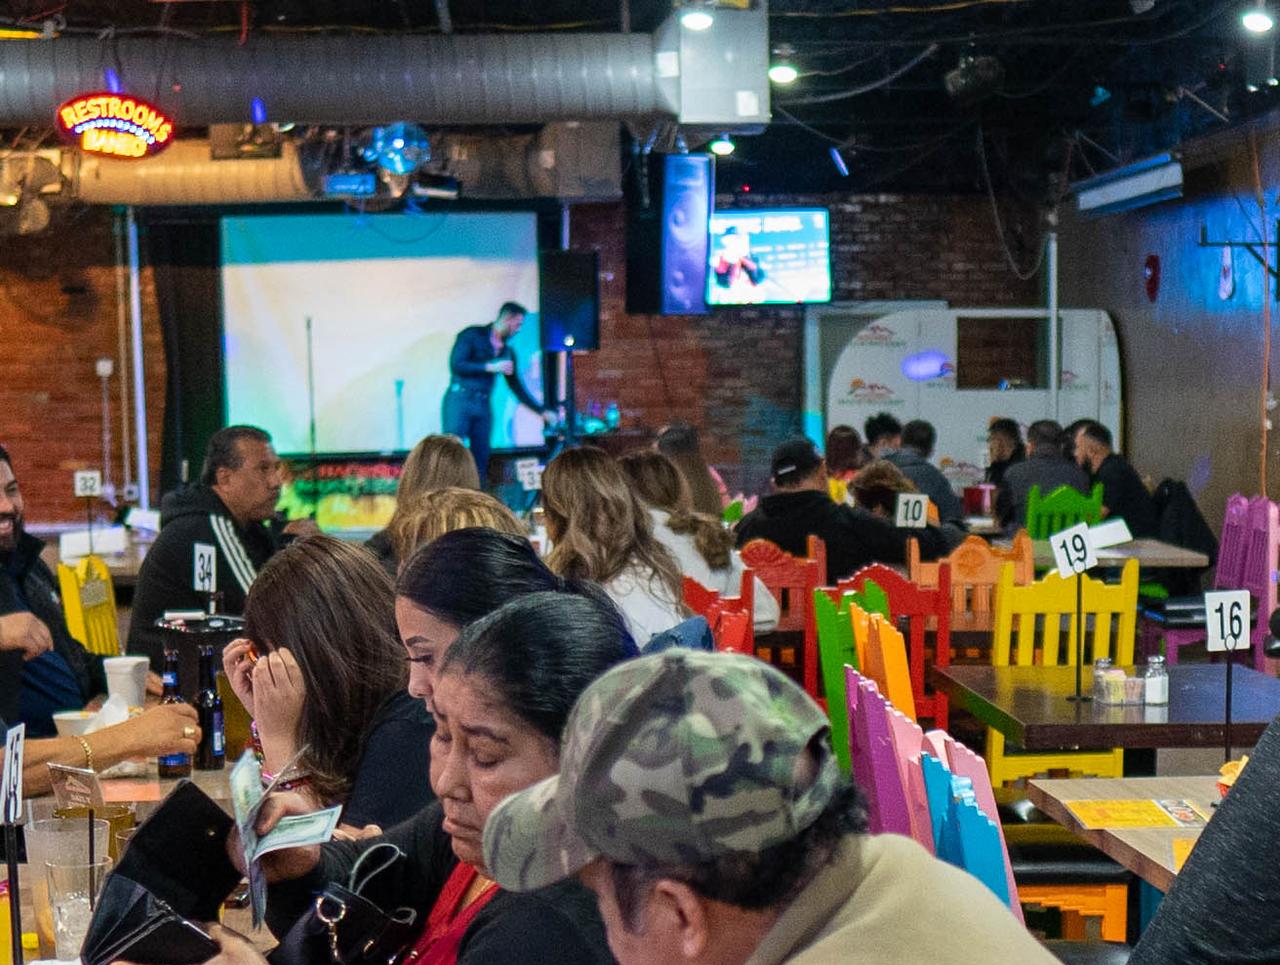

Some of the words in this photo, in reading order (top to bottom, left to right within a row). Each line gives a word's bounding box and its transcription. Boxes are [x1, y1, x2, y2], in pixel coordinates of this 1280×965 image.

[60, 97, 172, 143] RESTROOMS
[80, 476, 97, 492] 32
[903, 499, 923, 521] 10
[1059, 533, 1087, 567] 19
[198, 553, 212, 583] 34
[1214, 601, 1243, 640] 16
